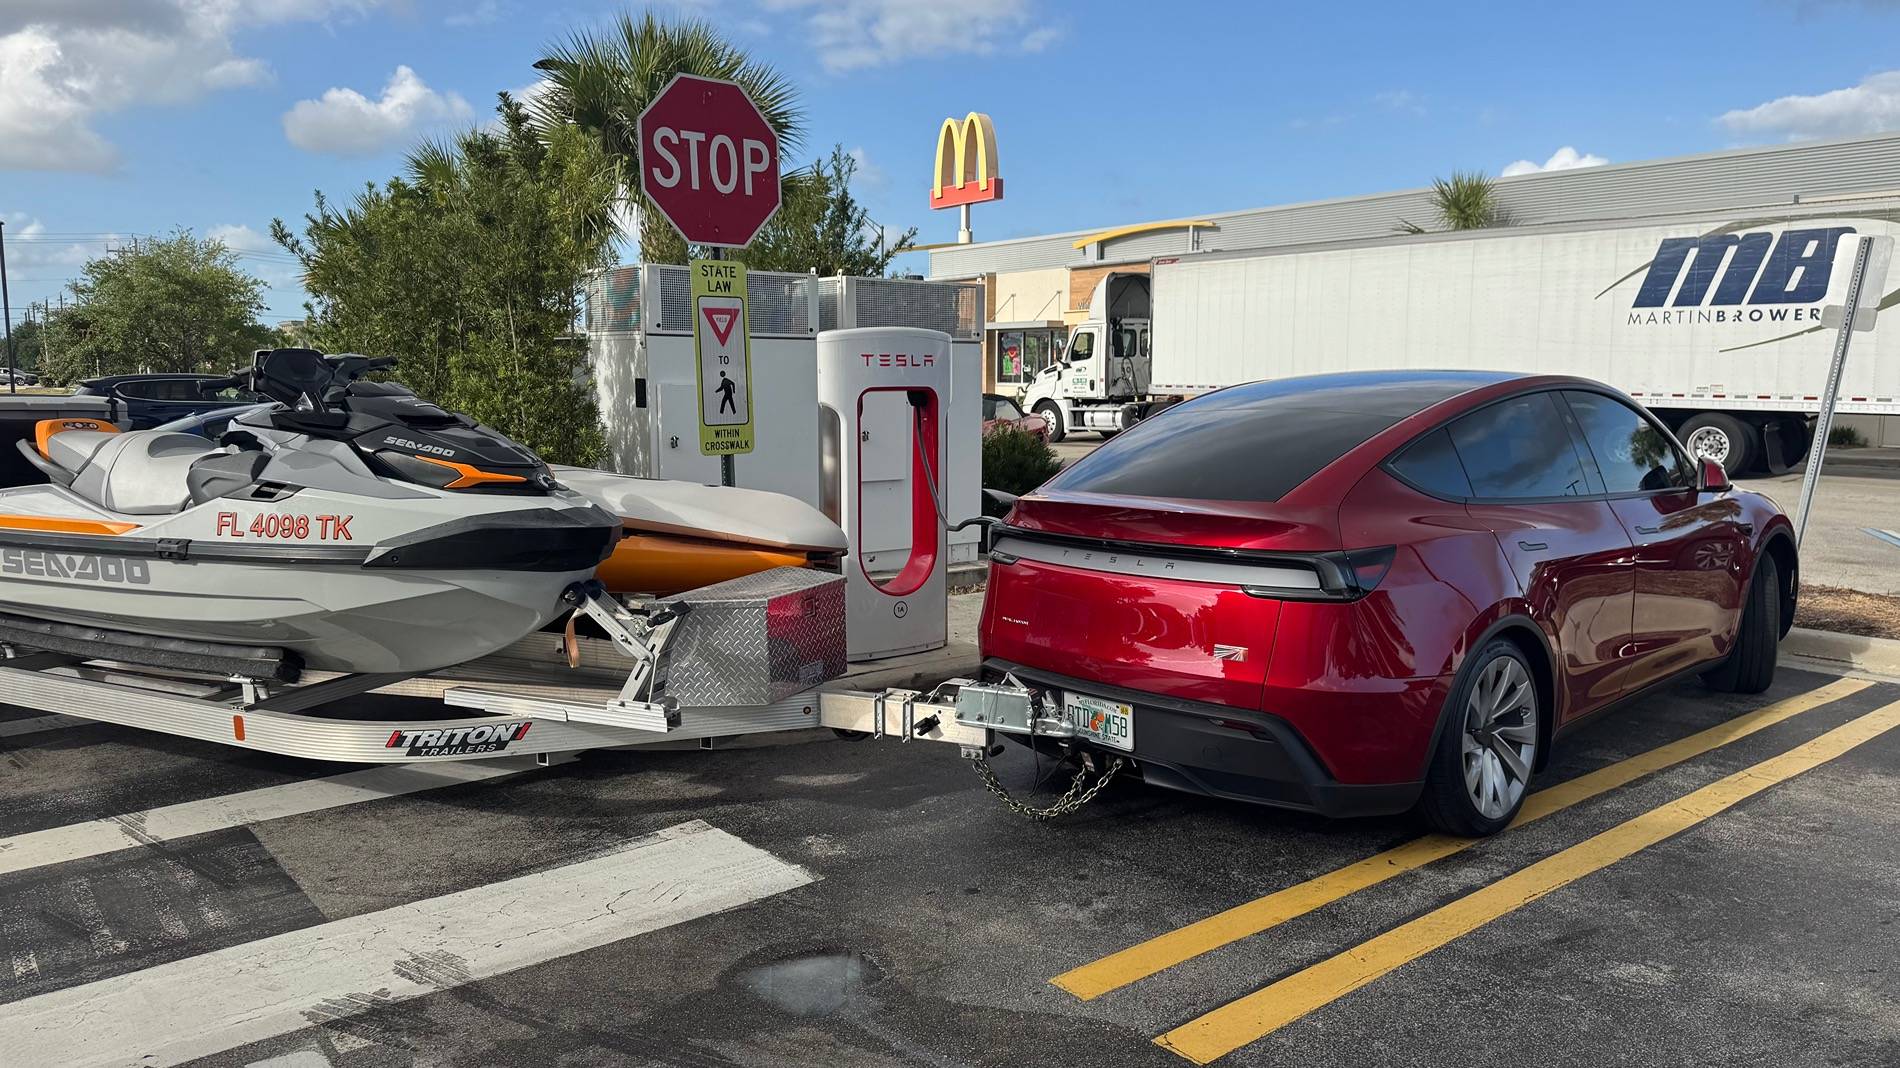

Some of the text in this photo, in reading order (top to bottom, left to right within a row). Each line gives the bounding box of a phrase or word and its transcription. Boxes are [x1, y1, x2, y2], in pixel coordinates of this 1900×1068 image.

[652, 126, 770, 196] STOP
[701, 265, 737, 279] STATE
[707, 280, 731, 293] LAW
[718, 356, 730, 365] TO
[860, 354, 934, 367] TESLA
[714, 429, 740, 440] WITHIN
[705, 439, 750, 451] CROSSWALK
[217, 511, 354, 541] FL 4098 TK
[1063, 550, 1175, 570] TESLA
[401, 722, 520, 748] TRITON
[421, 743, 497, 757] TRAILERS
